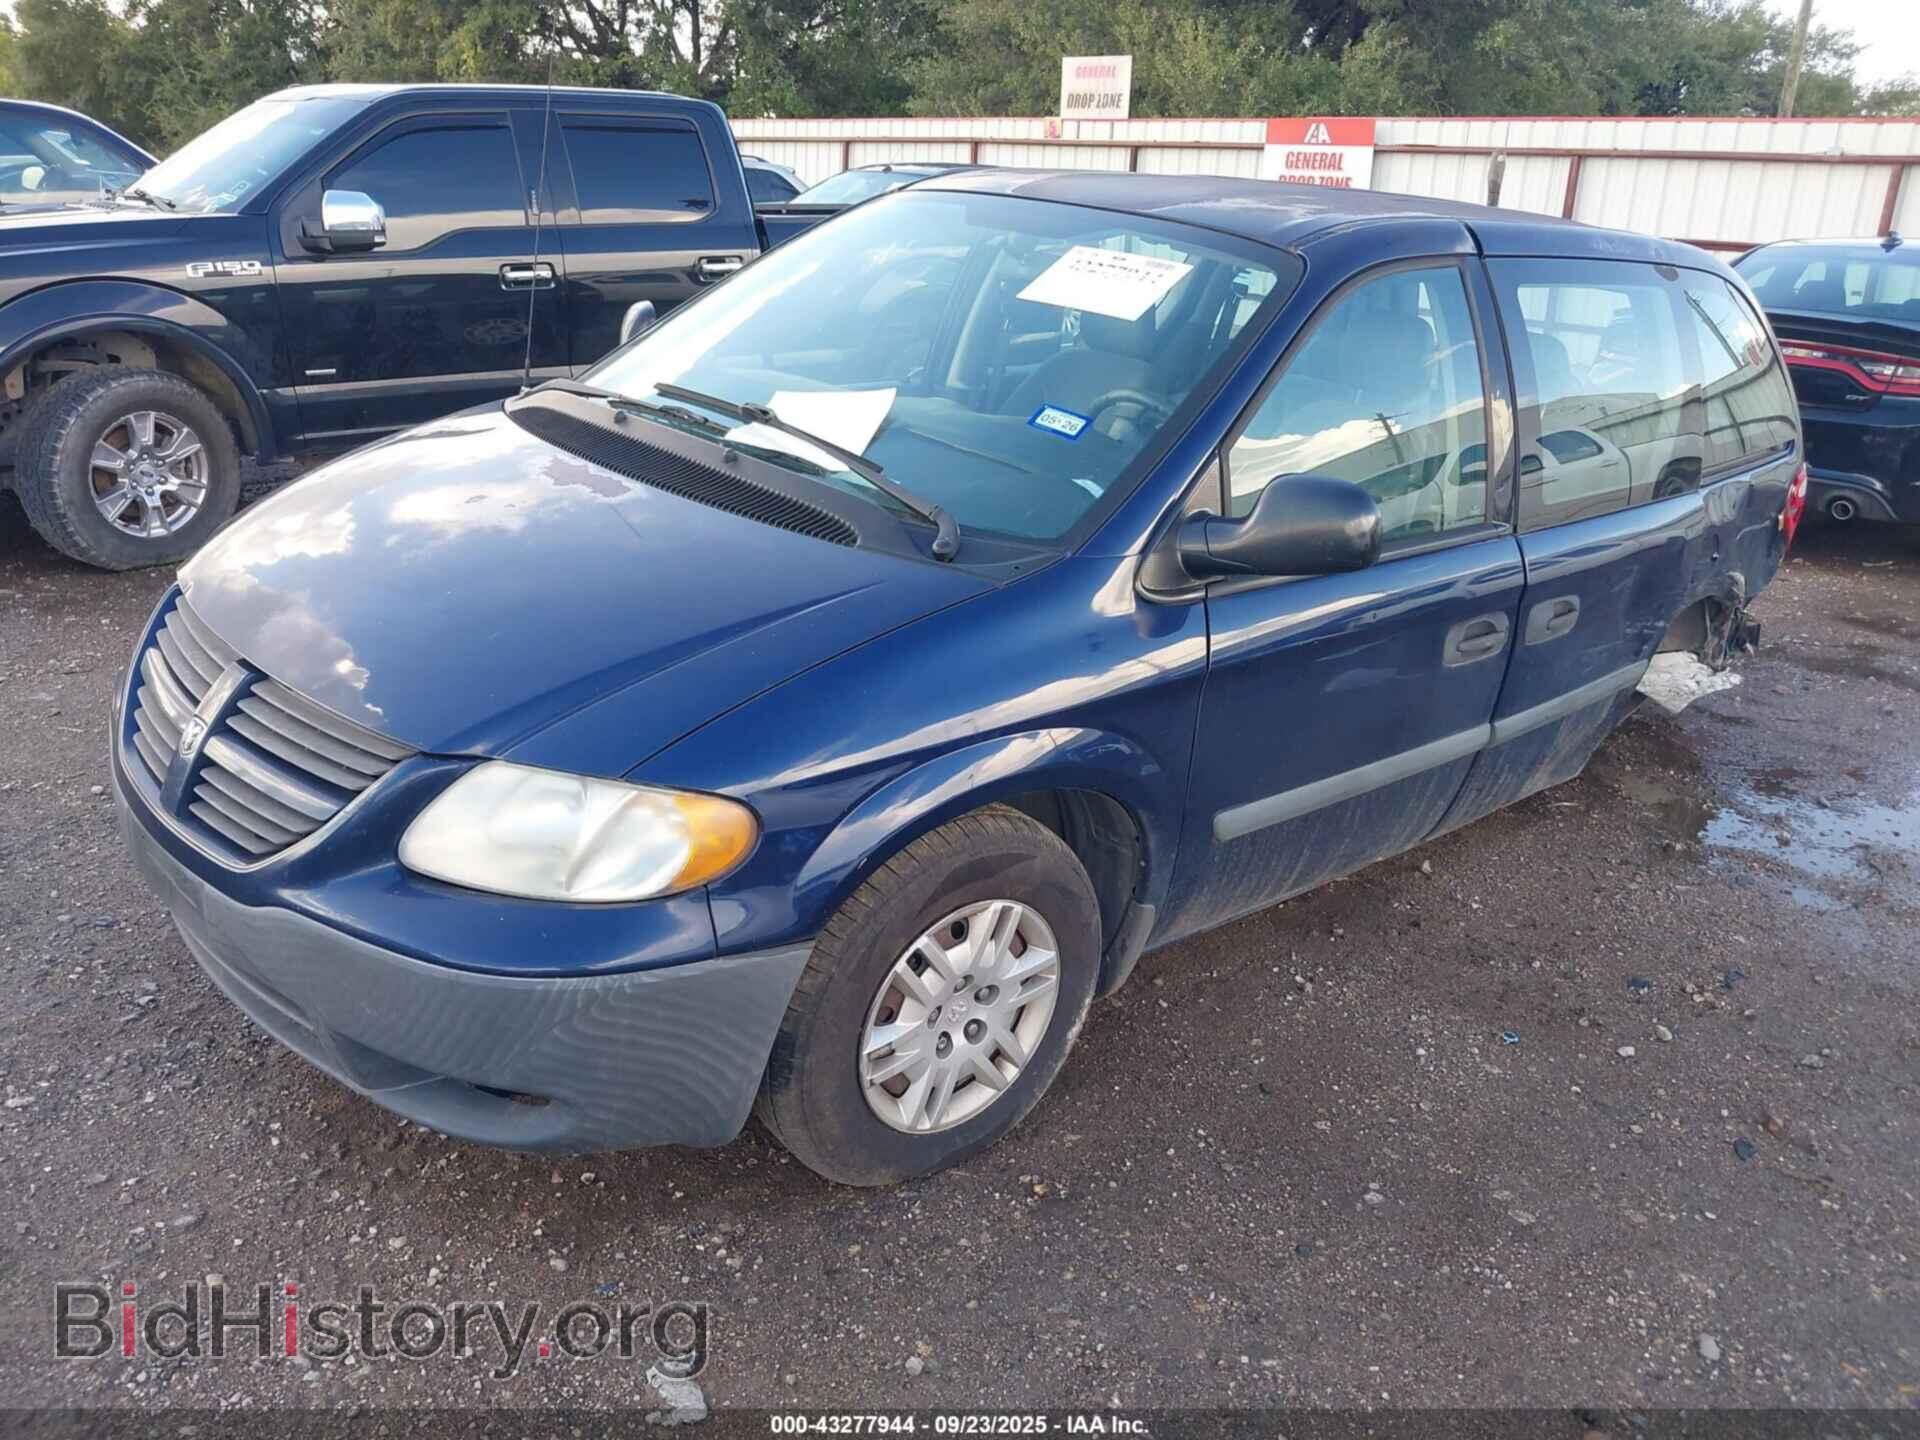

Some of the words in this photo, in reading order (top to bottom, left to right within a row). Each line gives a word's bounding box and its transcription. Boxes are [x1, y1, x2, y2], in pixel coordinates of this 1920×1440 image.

[1075, 65, 1117, 79] GENERAL
[1066, 92, 1095, 109] DROP
[1096, 92, 1124, 109] ZONE
[1285, 151, 1345, 171] GENERAL
